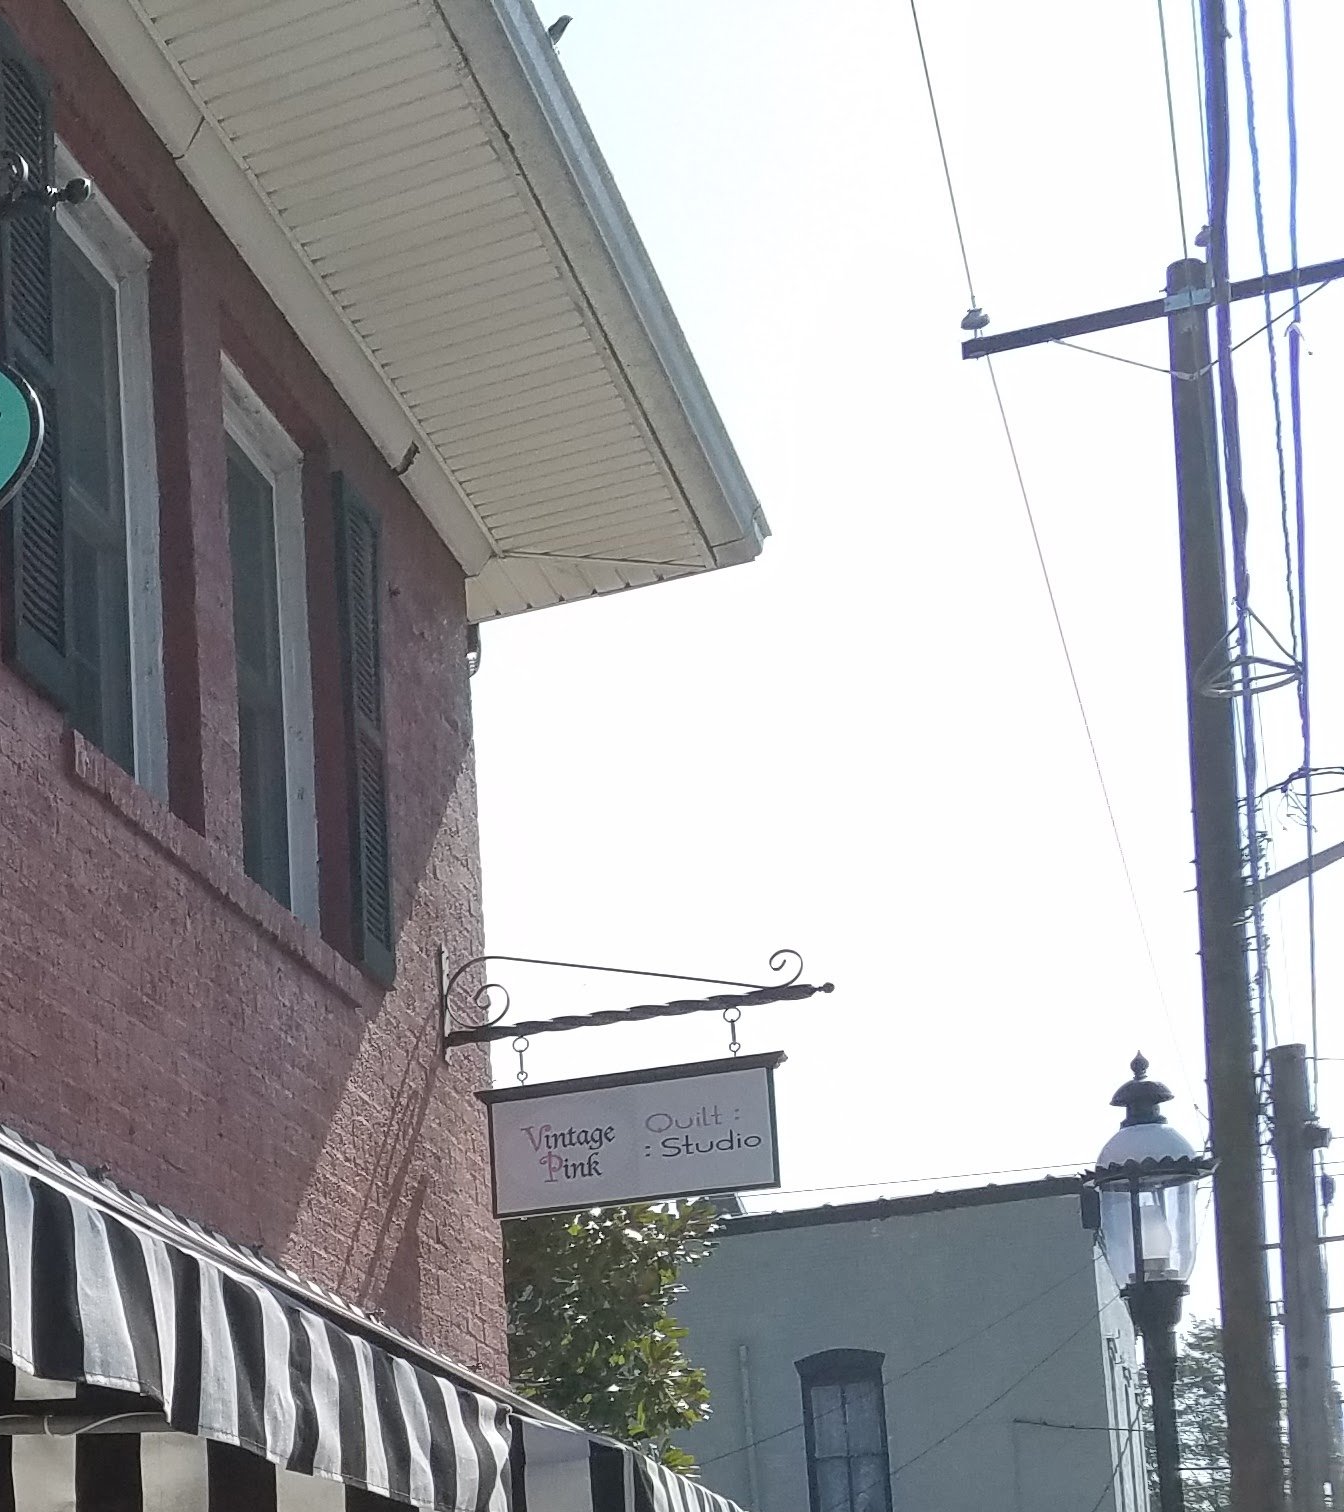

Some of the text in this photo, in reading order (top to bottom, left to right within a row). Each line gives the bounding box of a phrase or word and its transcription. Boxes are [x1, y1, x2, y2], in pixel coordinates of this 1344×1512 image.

[645, 1105, 723, 1134] Quilt
[521, 1124, 616, 1153] Vintage
[661, 1130, 762, 1158] Studio
[539, 1151, 603, 1183] Pink
